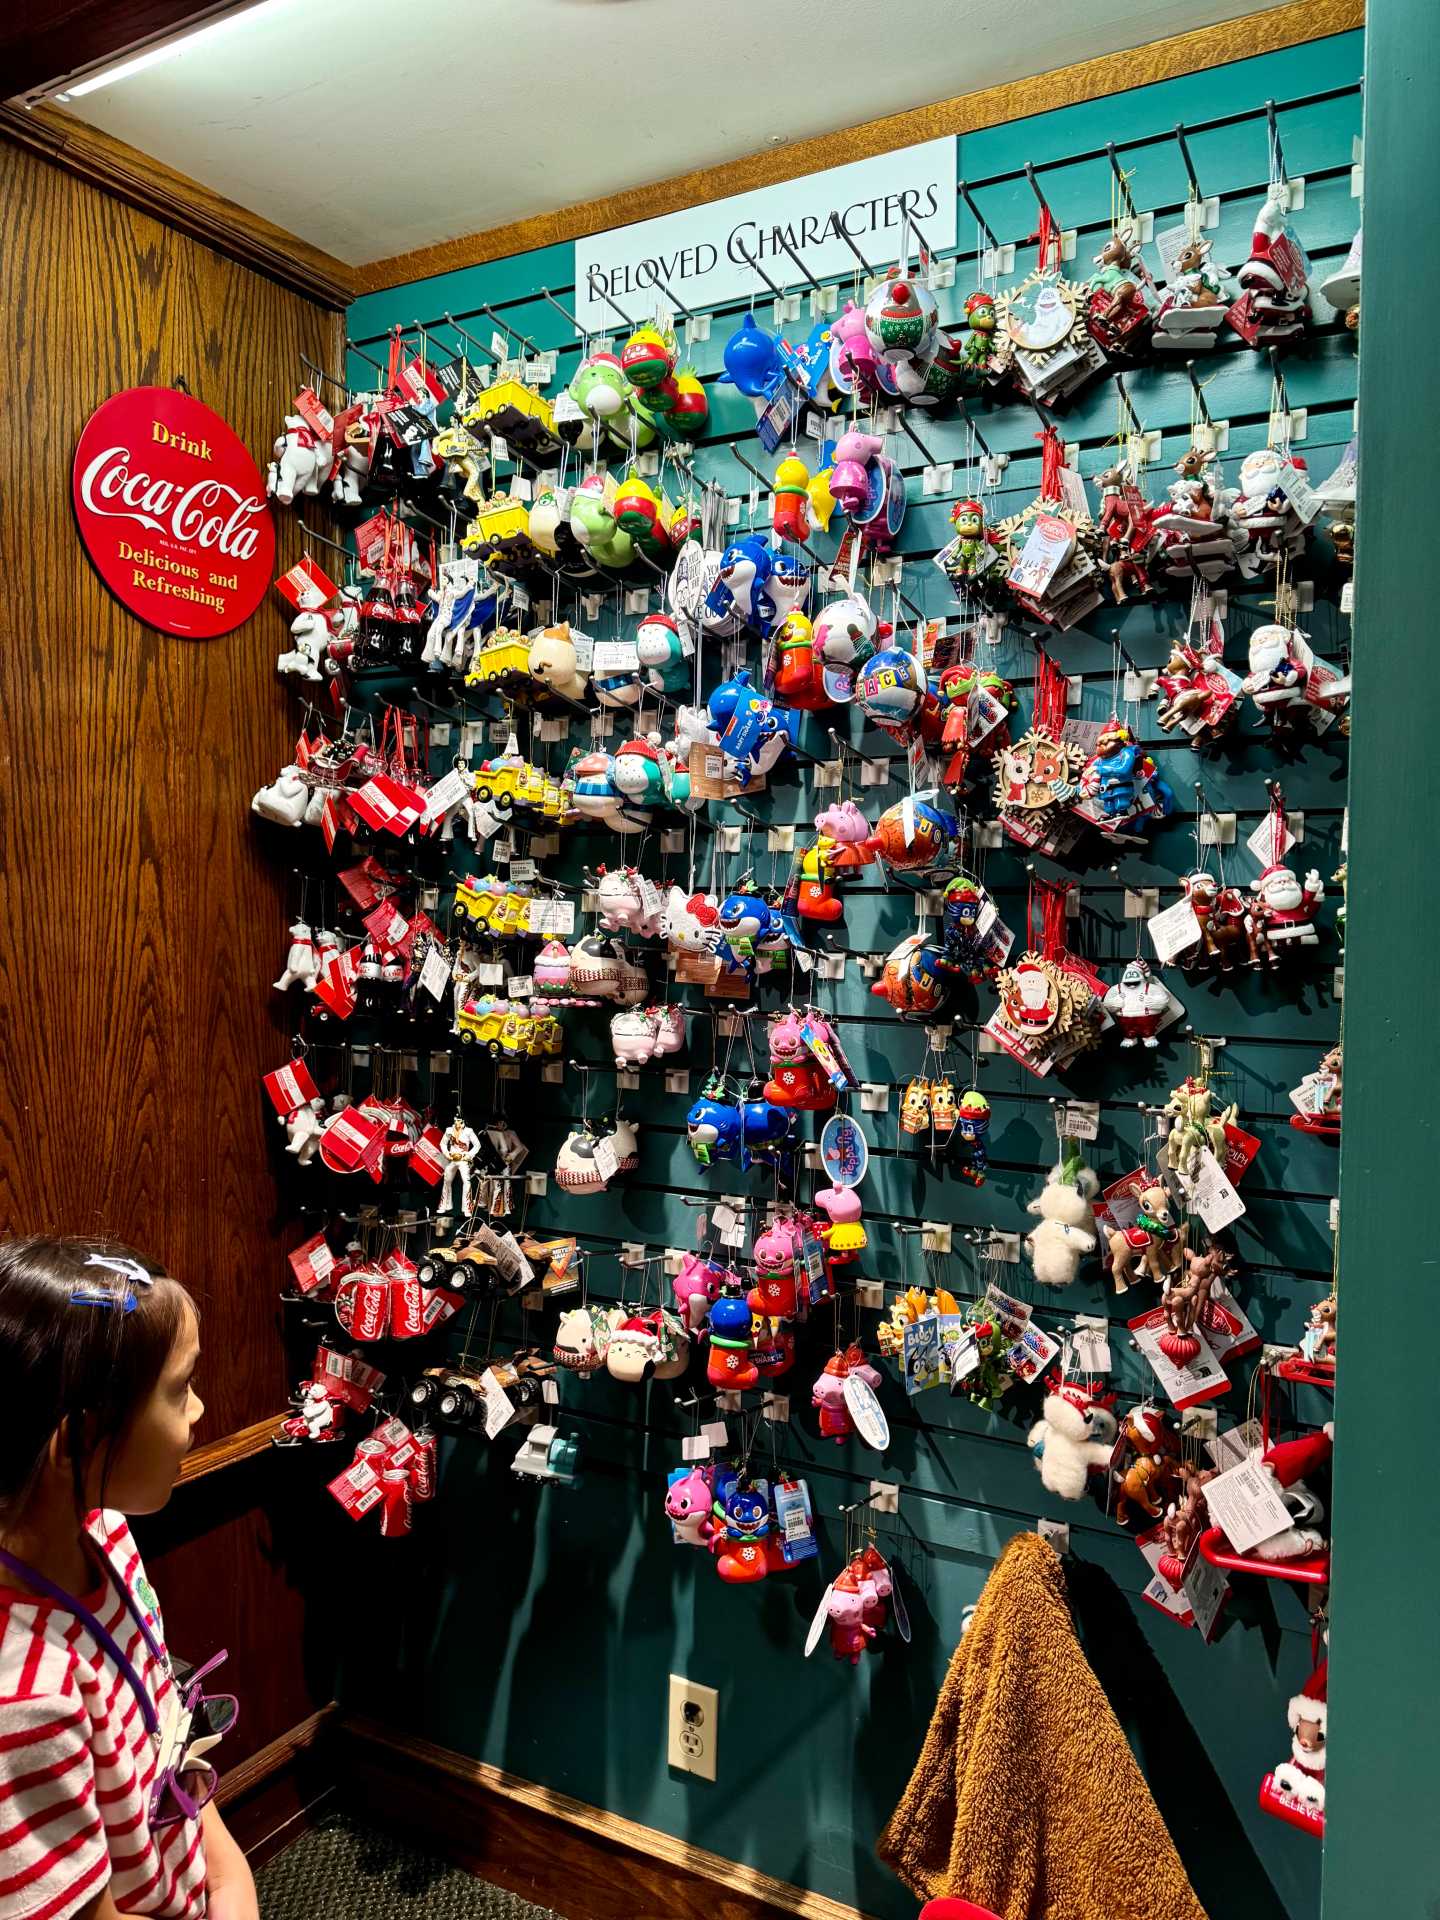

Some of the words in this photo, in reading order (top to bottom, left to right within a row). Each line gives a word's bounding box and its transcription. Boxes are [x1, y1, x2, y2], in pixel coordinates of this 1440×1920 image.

[587, 243, 718, 302] BELOVED
[726, 183, 938, 265] CHARACTERS
[151, 420, 213, 461] Drink
[81, 446, 267, 560] Coca-Cola
[118, 541, 199, 580] Delicious
[208, 570, 238, 591] and
[132, 569, 226, 615] Refreshing
[837, 1126, 854, 1144] Pig
[840, 1144, 861, 1175] Peppa
[360, 1286, 381, 1337] Coca-Cola
[404, 1282, 420, 1332] Coca-Cola
[414, 1452, 431, 1498] Coca-Cola
[1279, 1794, 1319, 1821] BELIEVE
